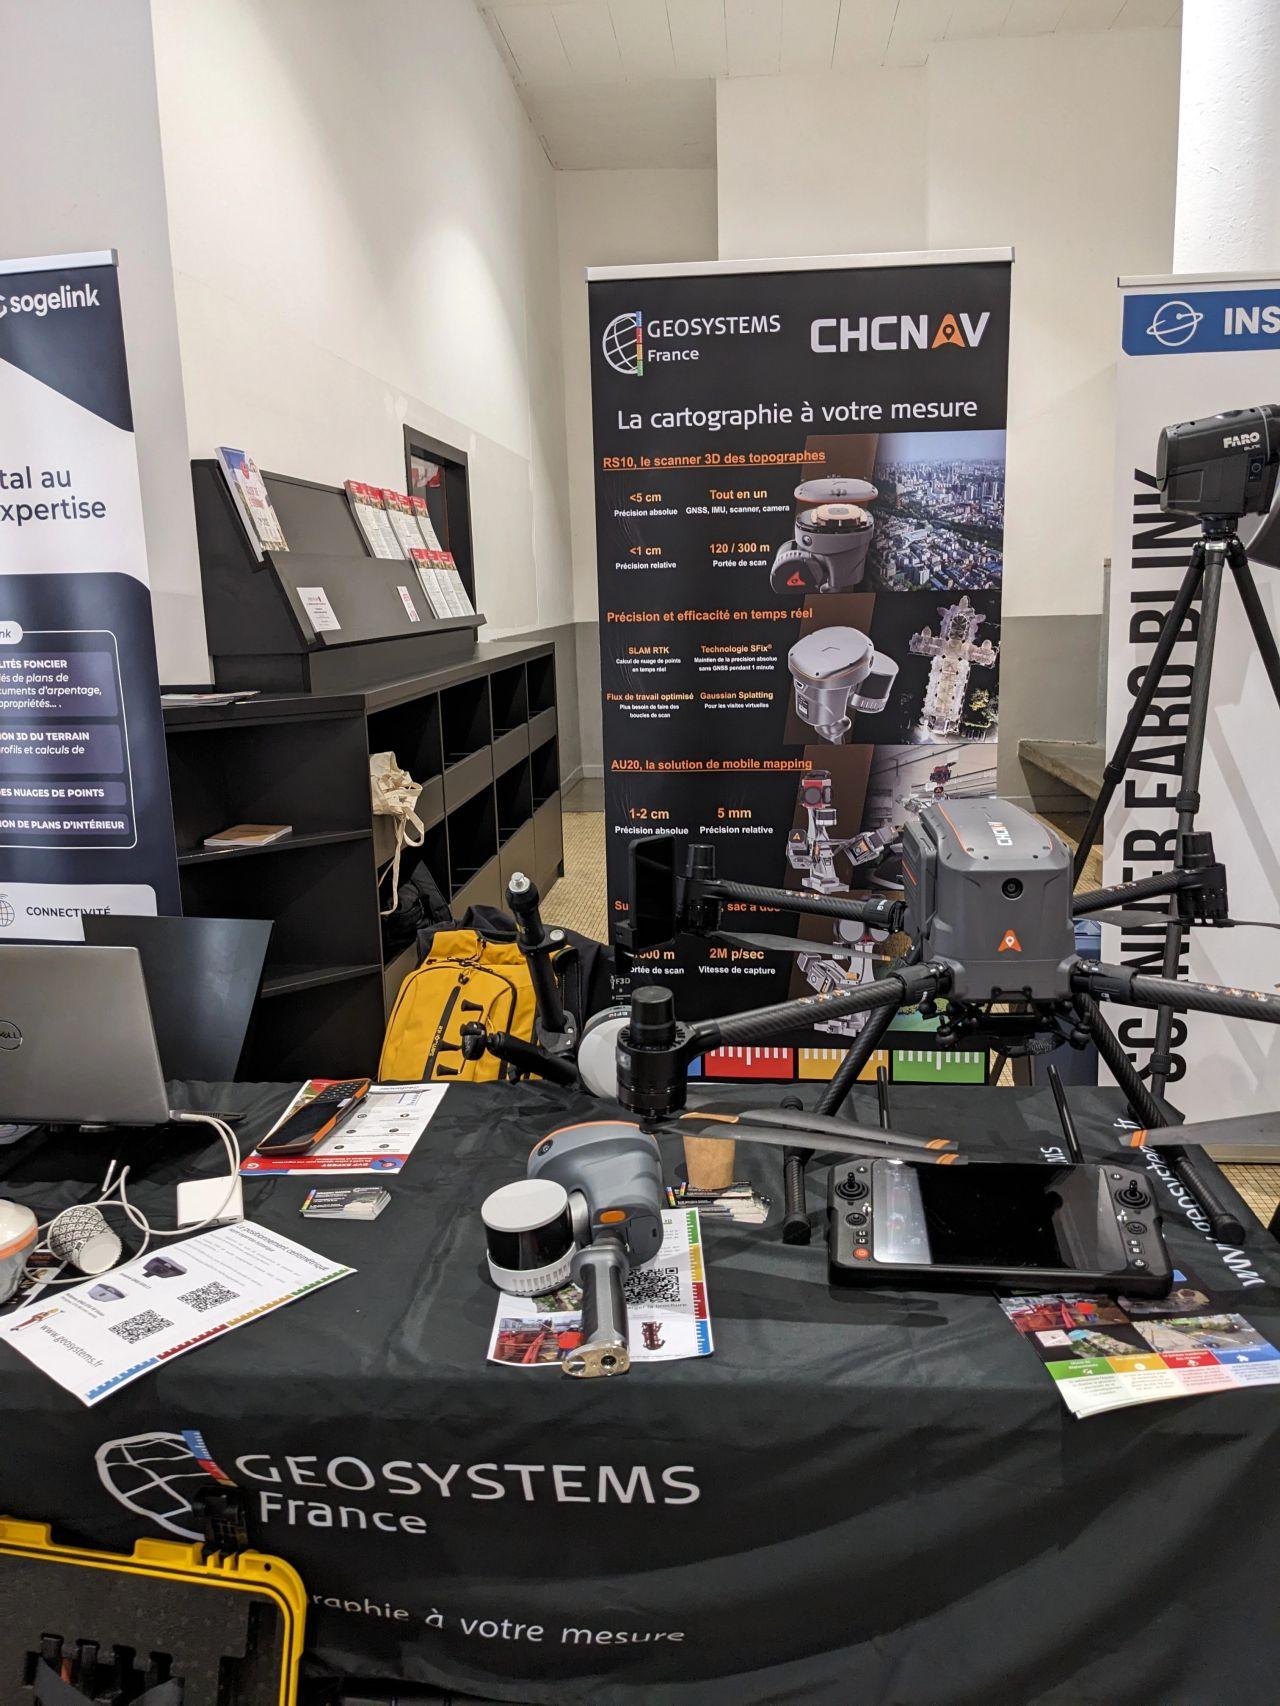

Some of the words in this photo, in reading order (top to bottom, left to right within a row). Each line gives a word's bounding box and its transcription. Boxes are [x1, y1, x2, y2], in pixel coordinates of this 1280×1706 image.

[10, 284, 100, 317] sogelink
[647, 315, 781, 338] GEOSYSTEMS
[810, 312, 990, 353] CHCNAV
[648, 348, 700, 363] France
[618, 410, 642, 430] La
[650, 402, 792, 431] cartographie
[800, 401, 814, 423] à
[822, 401, 883, 422] votre
[891, 400, 978, 419] mesure
[1222, 431, 1260, 449] FARO
[603, 457, 637, 469] RS10,
[641, 456, 650, 466] le
[654, 456, 701, 467] scanner
[705, 454, 720, 464] 3D
[724, 454, 745, 464] des
[749, 450, 825, 466] topographes
[41, 469, 71, 488] au
[630, 493, 642, 502] <5
[646, 494, 662, 502] cm
[710, 490, 733, 500] Tout
[737, 491, 750, 499] en
[0, 495, 106, 526] xpertise
[614, 509, 648, 517] Précision
[649, 508, 678, 516] absolue
[686, 507, 709, 515] GNSS,
[712, 506, 728, 514] IMU,
[730, 506, 761, 514] scanner,
[630, 547, 643, 556] <1
[646, 547, 662, 555] cm
[710, 544, 728, 554] 120
[738, 543, 756, 553] 300
[760, 544, 770, 552] m
[616, 562, 648, 570] Précision
[651, 561, 676, 569] relative
[713, 559, 736, 567] Portée
[738, 559, 747, 567] de
[607, 611, 660, 623] Précision
[663, 612, 675, 621] et
[678, 609, 730, 621] efficacité
[733, 611, 747, 620] en
[751, 609, 787, 621] temps
[790, 608, 813, 619] réel
[628, 647, 651, 655] SLAM
[653, 646, 669, 654] RTK
[701, 645, 748, 654] Technologie
[24, 660, 67, 668] FONCIER
[729, 664, 750, 672] pendant
[13, 674, 24, 682] de
[26, 674, 53, 684] plans
[56, 673, 69, 682] de
[38, 686, 102, 696] d'arpentage,
[700, 692, 736, 700] Gaussian
[738, 691, 773, 700] Splatting
[661, 693, 694, 701] optimisé
[46, 732, 90, 740] TERRAIN
[24, 746, 33, 754] et
[35, 745, 69, 754] calculs
[72, 745, 85, 754] de
[611, 760, 643, 771] AU20,
[646, 760, 655, 769] la
[659, 760, 702, 770] solution
[706, 759, 720, 769] de
[723, 759, 760, 769] mobile
[764, 759, 812, 771] mapping
[14, 789, 49, 797] NUAGES
[52, 789, 65, 797] DE
[68, 789, 104, 797] POINTS
[629, 808, 647, 819] 1-2
[651, 809, 669, 819] cm
[717, 808, 724, 818] 5
[728, 809, 751, 818] mm
[31, 821, 61, 829] PLANS
[63, 819, 124, 829] D'INTÉRIEUR
[615, 826, 653, 835] Précision
[655, 826, 689, 835] absolue
[700, 826, 740, 834] Précision
[742, 826, 773, 834] relative
[26, 906, 111, 918] CONNECTIVITÉ
[727, 903, 746, 911] sac
[663, 951, 675, 959] m
[710, 948, 728, 959] 2M
[731, 948, 765, 961] p/sec
[630, 966, 650, 974] ortée
[652, 966, 662, 974] de
[699, 966, 729, 974] Vitesse
[732, 966, 741, 974] de
[744, 967, 776, 975] capture
[234, 1454, 701, 1506] GEOSYSTEMS
[259, 1491, 428, 1535] France
[313, 1593, 410, 1622] raphie
[425, 1607, 444, 1629] à
[460, 1617, 545, 1642] votre
[561, 1626, 686, 1645] mesure
